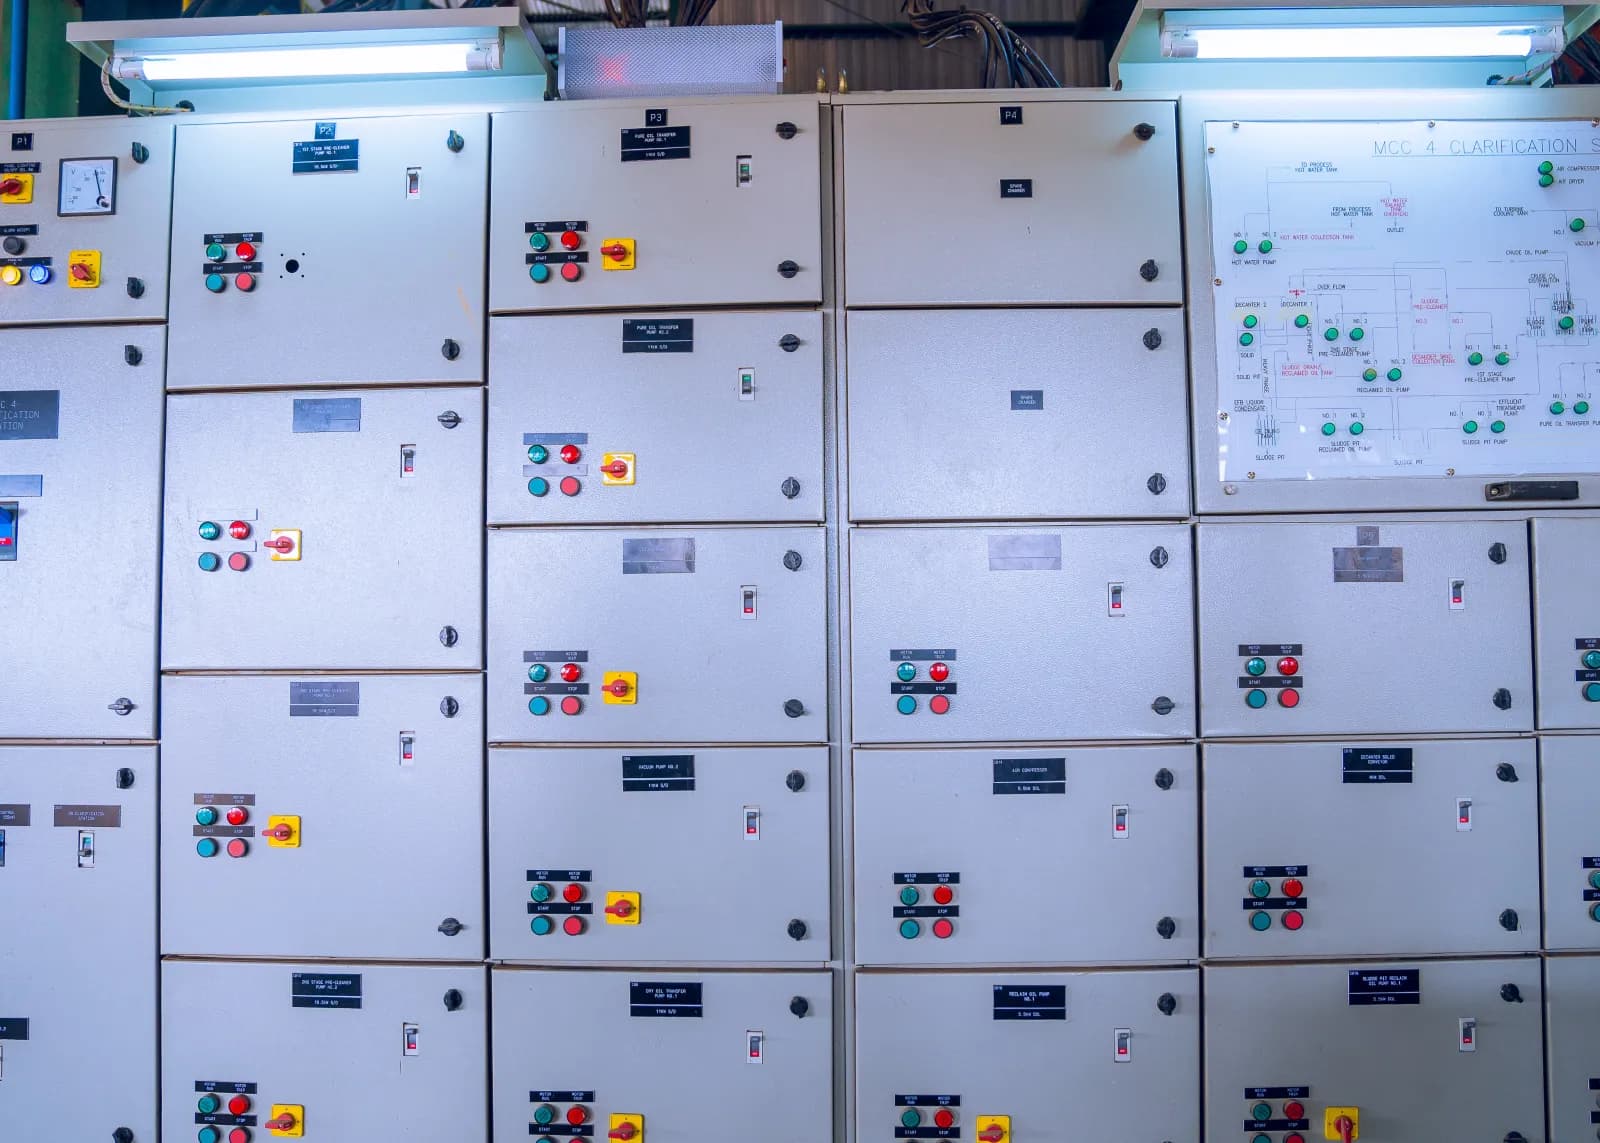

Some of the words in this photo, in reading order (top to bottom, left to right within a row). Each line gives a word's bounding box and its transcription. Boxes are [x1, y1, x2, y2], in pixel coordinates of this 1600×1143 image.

[650, 113, 661, 121] P3
[1006, 111, 1016, 119] P4
[320, 126, 332, 135] P2
[1374, 140, 1412, 155] MCC
[1426, 140, 1435, 154] 4
[1450, 139, 1577, 154] CLARIFICATION
[0, 411, 39, 419] ICATION
